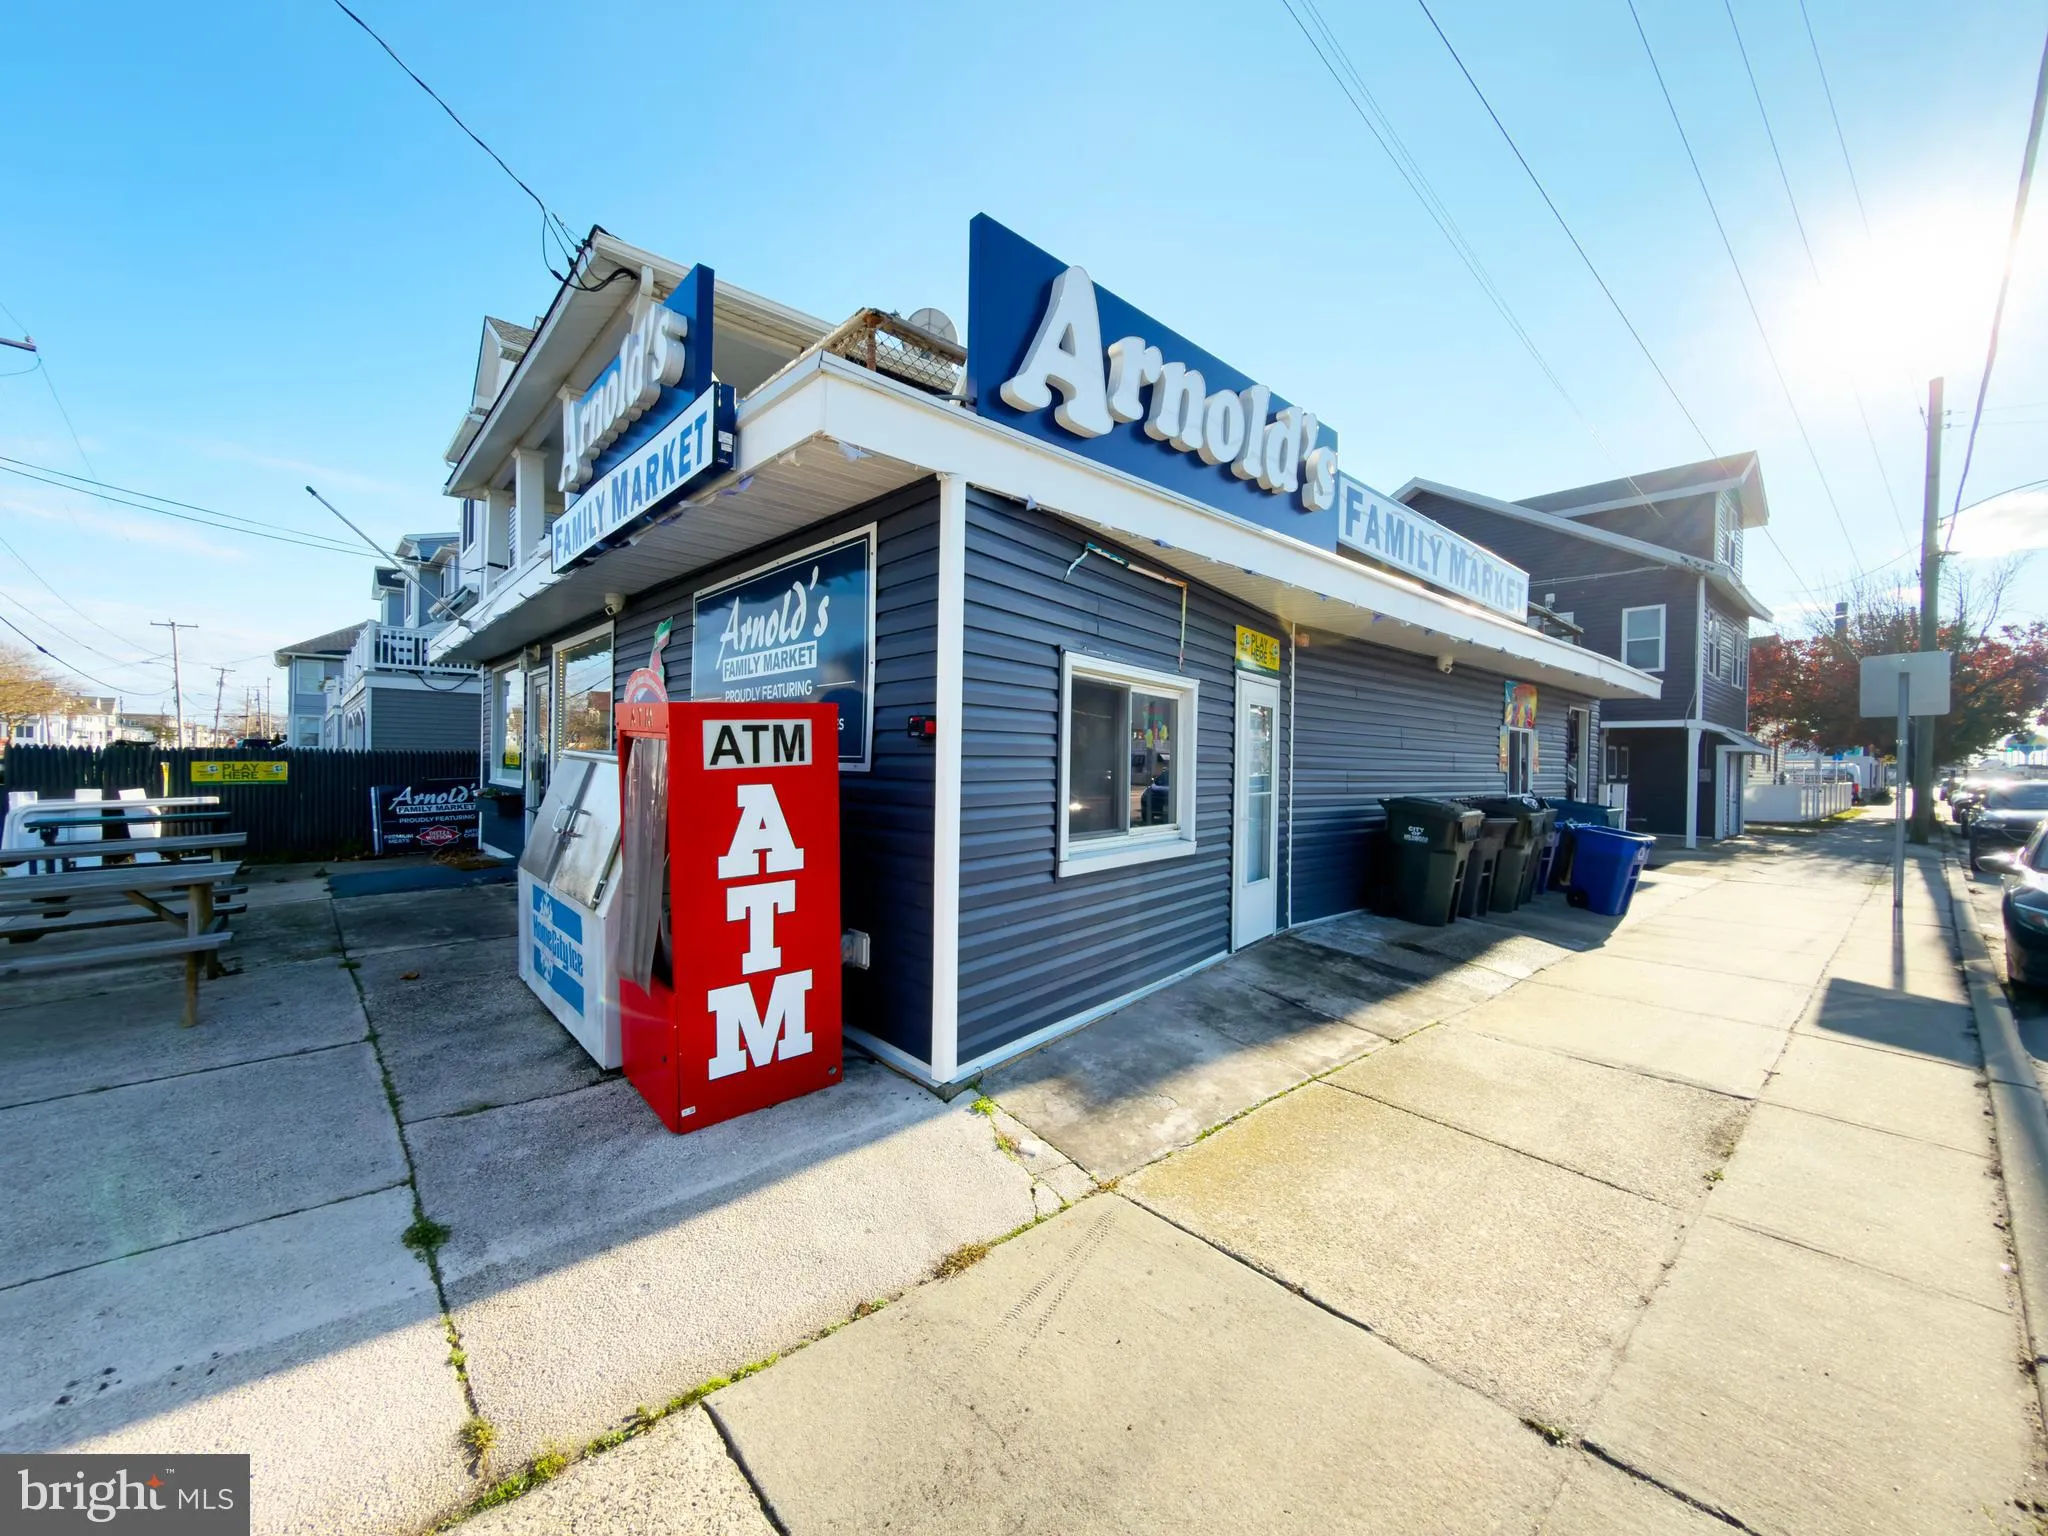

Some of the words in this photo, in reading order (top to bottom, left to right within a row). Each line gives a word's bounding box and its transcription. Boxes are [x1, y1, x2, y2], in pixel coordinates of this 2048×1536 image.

[558, 302, 688, 492] Arnold's
[1000, 265, 1338, 512] Arnold's
[555, 490, 606, 565] FAMILY
[611, 410, 708, 524] MARKET
[1345, 486, 1443, 577] FAMILY
[1450, 543, 1525, 616] MARKET
[716, 565, 830, 670] Arnold's
[1251, 633, 1269, 651] PLAY
[724, 655, 760, 679] FAMILY
[763, 645, 815, 673] MARKET
[725, 685, 761, 703] PROUDLY
[762, 679, 813, 699] FEATURING
[709, 724, 805, 766] ATM
[222, 763, 260, 772] PLAY
[222, 771, 259, 780] HERE
[398, 805, 433, 813] FAMILY
[436, 803, 476, 811] MARKET
